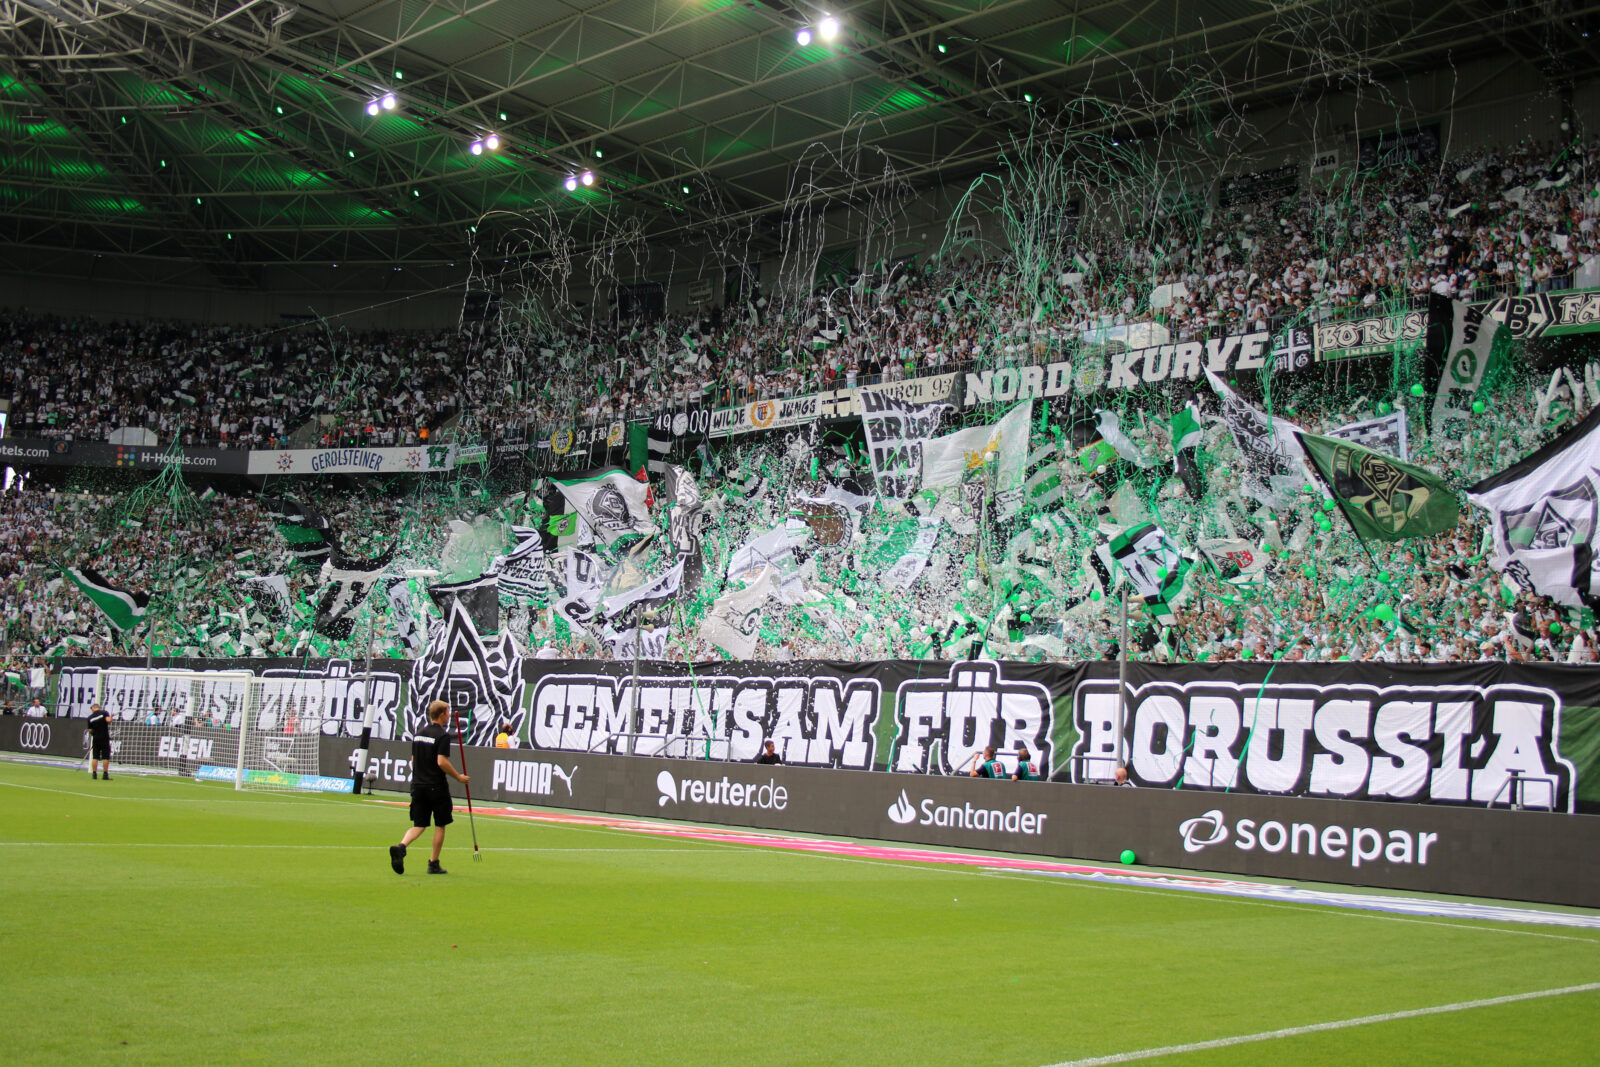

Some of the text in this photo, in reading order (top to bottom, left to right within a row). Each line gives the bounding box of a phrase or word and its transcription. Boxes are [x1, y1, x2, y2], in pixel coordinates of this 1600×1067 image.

[1319, 313, 1429, 352] BORUS
[964, 332, 1270, 406] NORD KURVE
[713, 408, 746, 429] WILDE
[141, 452, 217, 467] H-Hotels.com
[311, 449, 383, 471] GEROLSTEINER
[57, 673, 98, 718] DIE
[533, 671, 1561, 807] GEMEINSAM FÜR BORUSSIA
[492, 759, 552, 795] PUMA
[680, 777, 788, 811] reuter.de
[919, 798, 1048, 836] Santander
[1234, 818, 1438, 868] sonepar
